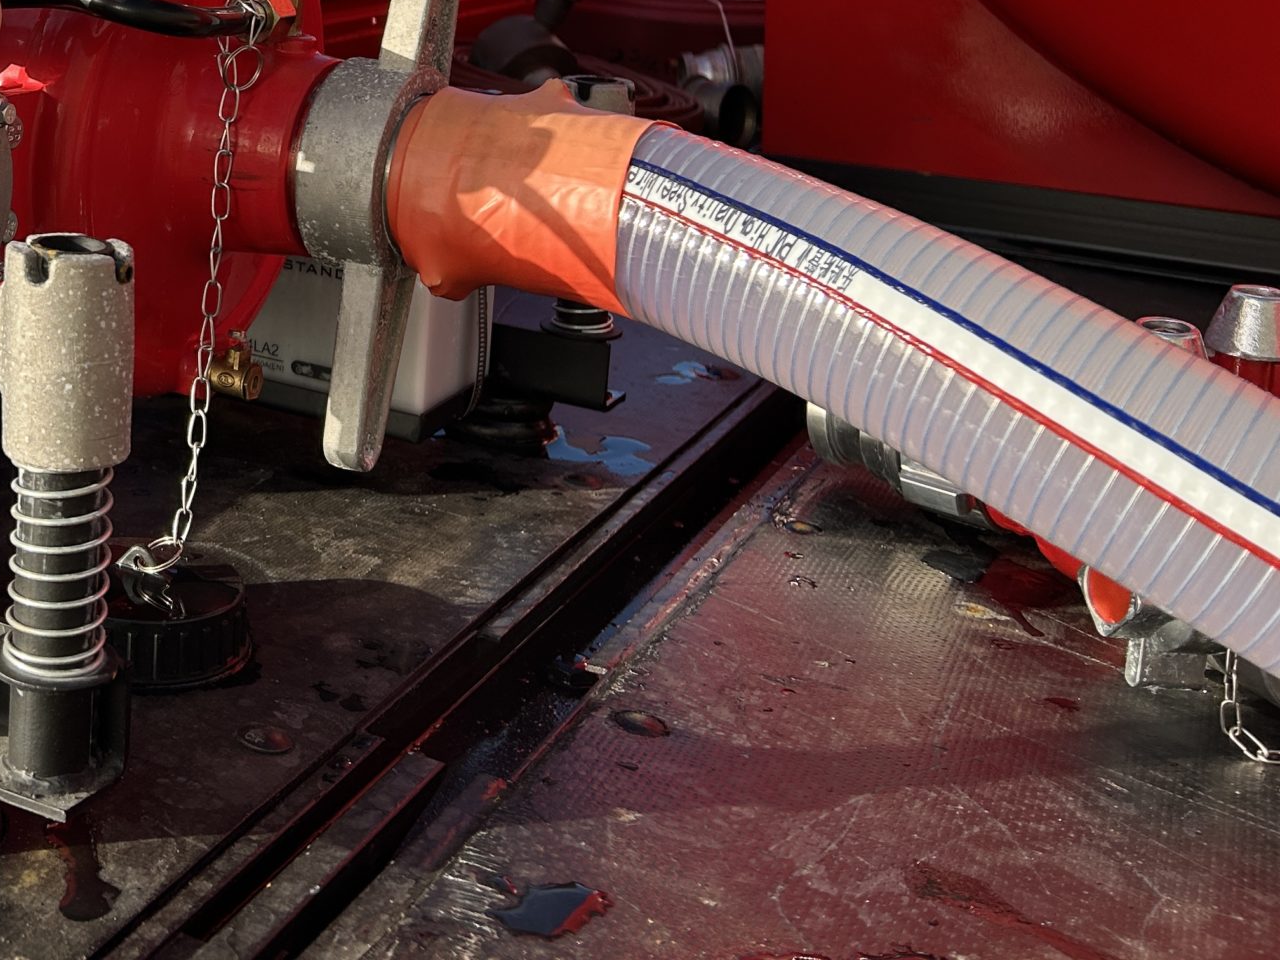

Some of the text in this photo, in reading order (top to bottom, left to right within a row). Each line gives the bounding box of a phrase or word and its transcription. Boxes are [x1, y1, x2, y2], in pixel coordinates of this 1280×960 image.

[627, 166, 655, 200] Wire
[657, 176, 693, 213] Steel
[739, 210, 771, 249] High
[768, 227, 799, 259] PVC
